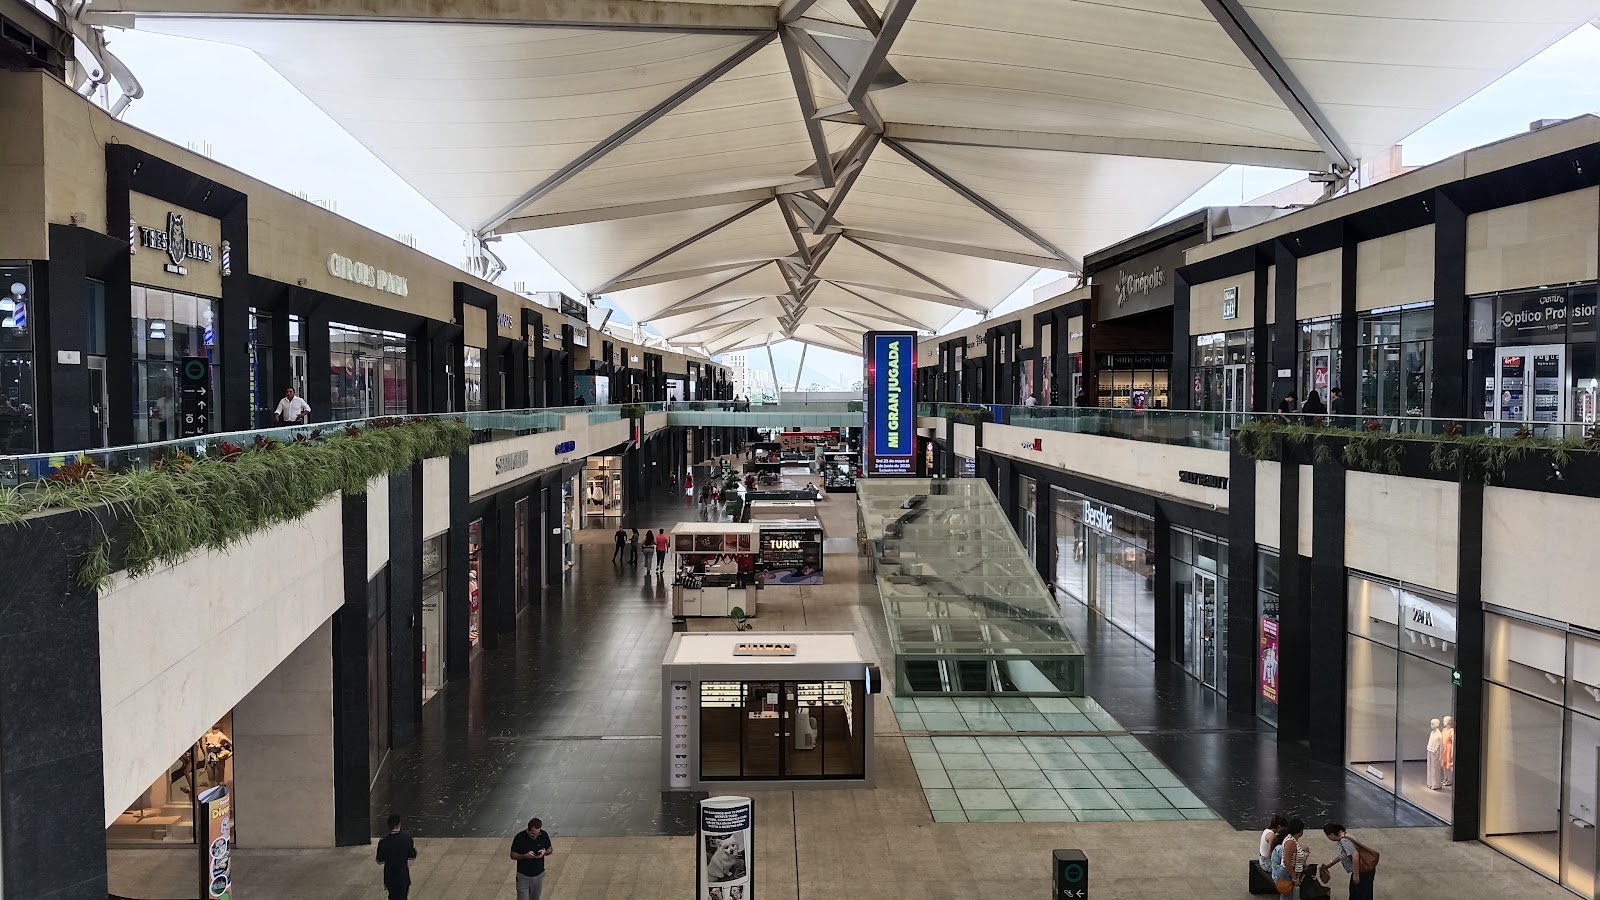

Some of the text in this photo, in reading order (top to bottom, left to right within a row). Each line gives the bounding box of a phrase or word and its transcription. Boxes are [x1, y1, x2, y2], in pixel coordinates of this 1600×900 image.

[327, 252, 375, 288] CIRCUS
[888, 341, 901, 448] MI GRAN JUGADA
[1084, 500, 1113, 533] Bershka
[770, 539, 800, 549] TURIN
